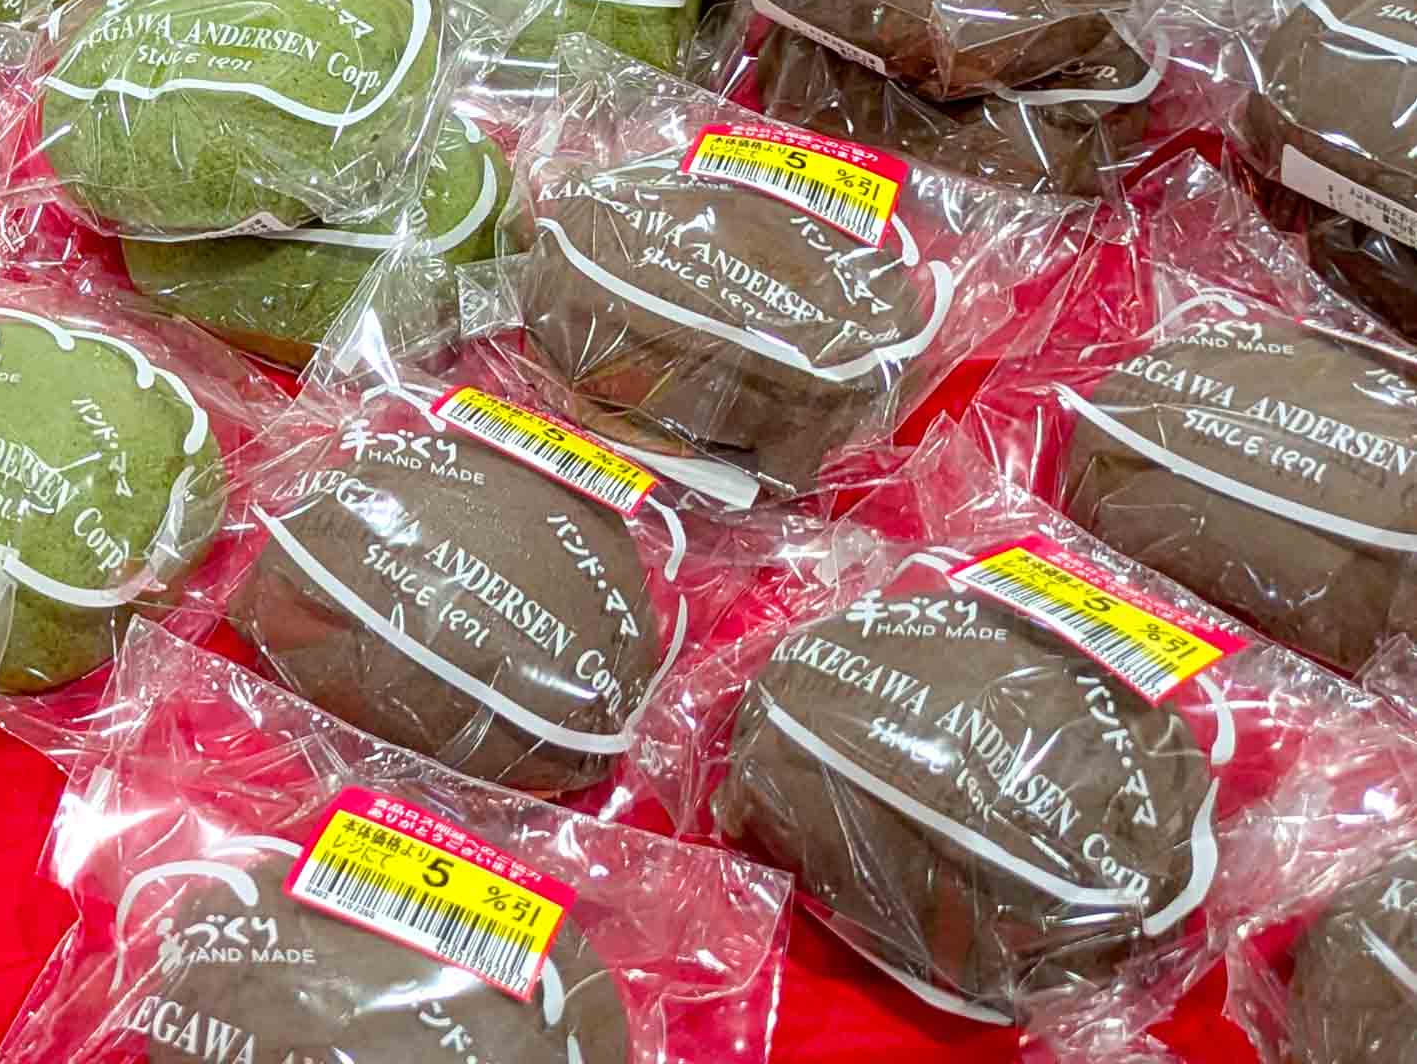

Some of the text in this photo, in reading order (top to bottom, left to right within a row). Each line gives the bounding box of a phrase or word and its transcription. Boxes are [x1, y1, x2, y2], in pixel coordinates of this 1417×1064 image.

[189, 19, 383, 92] ANDERSEN Corp.
[784, 151, 808, 170] 5
[1237, 341, 1296, 355] MADE
[541, 427, 568, 442] 5
[1183, 408, 1265, 456] SINCE
[1245, 395, 1417, 477] ANDERSEN
[368, 449, 487, 487] HAND MADE
[363, 543, 430, 606] SINCE
[424, 540, 577, 660] ANDERSEN
[1082, 594, 1119, 613] 5
[877, 621, 1007, 642] HAND MADE
[332, 833, 393, 869] レジにて
[341, 818, 431, 863] 本体価格より
[421, 857, 455, 888] 5
[251, 948, 318, 965] MADE
